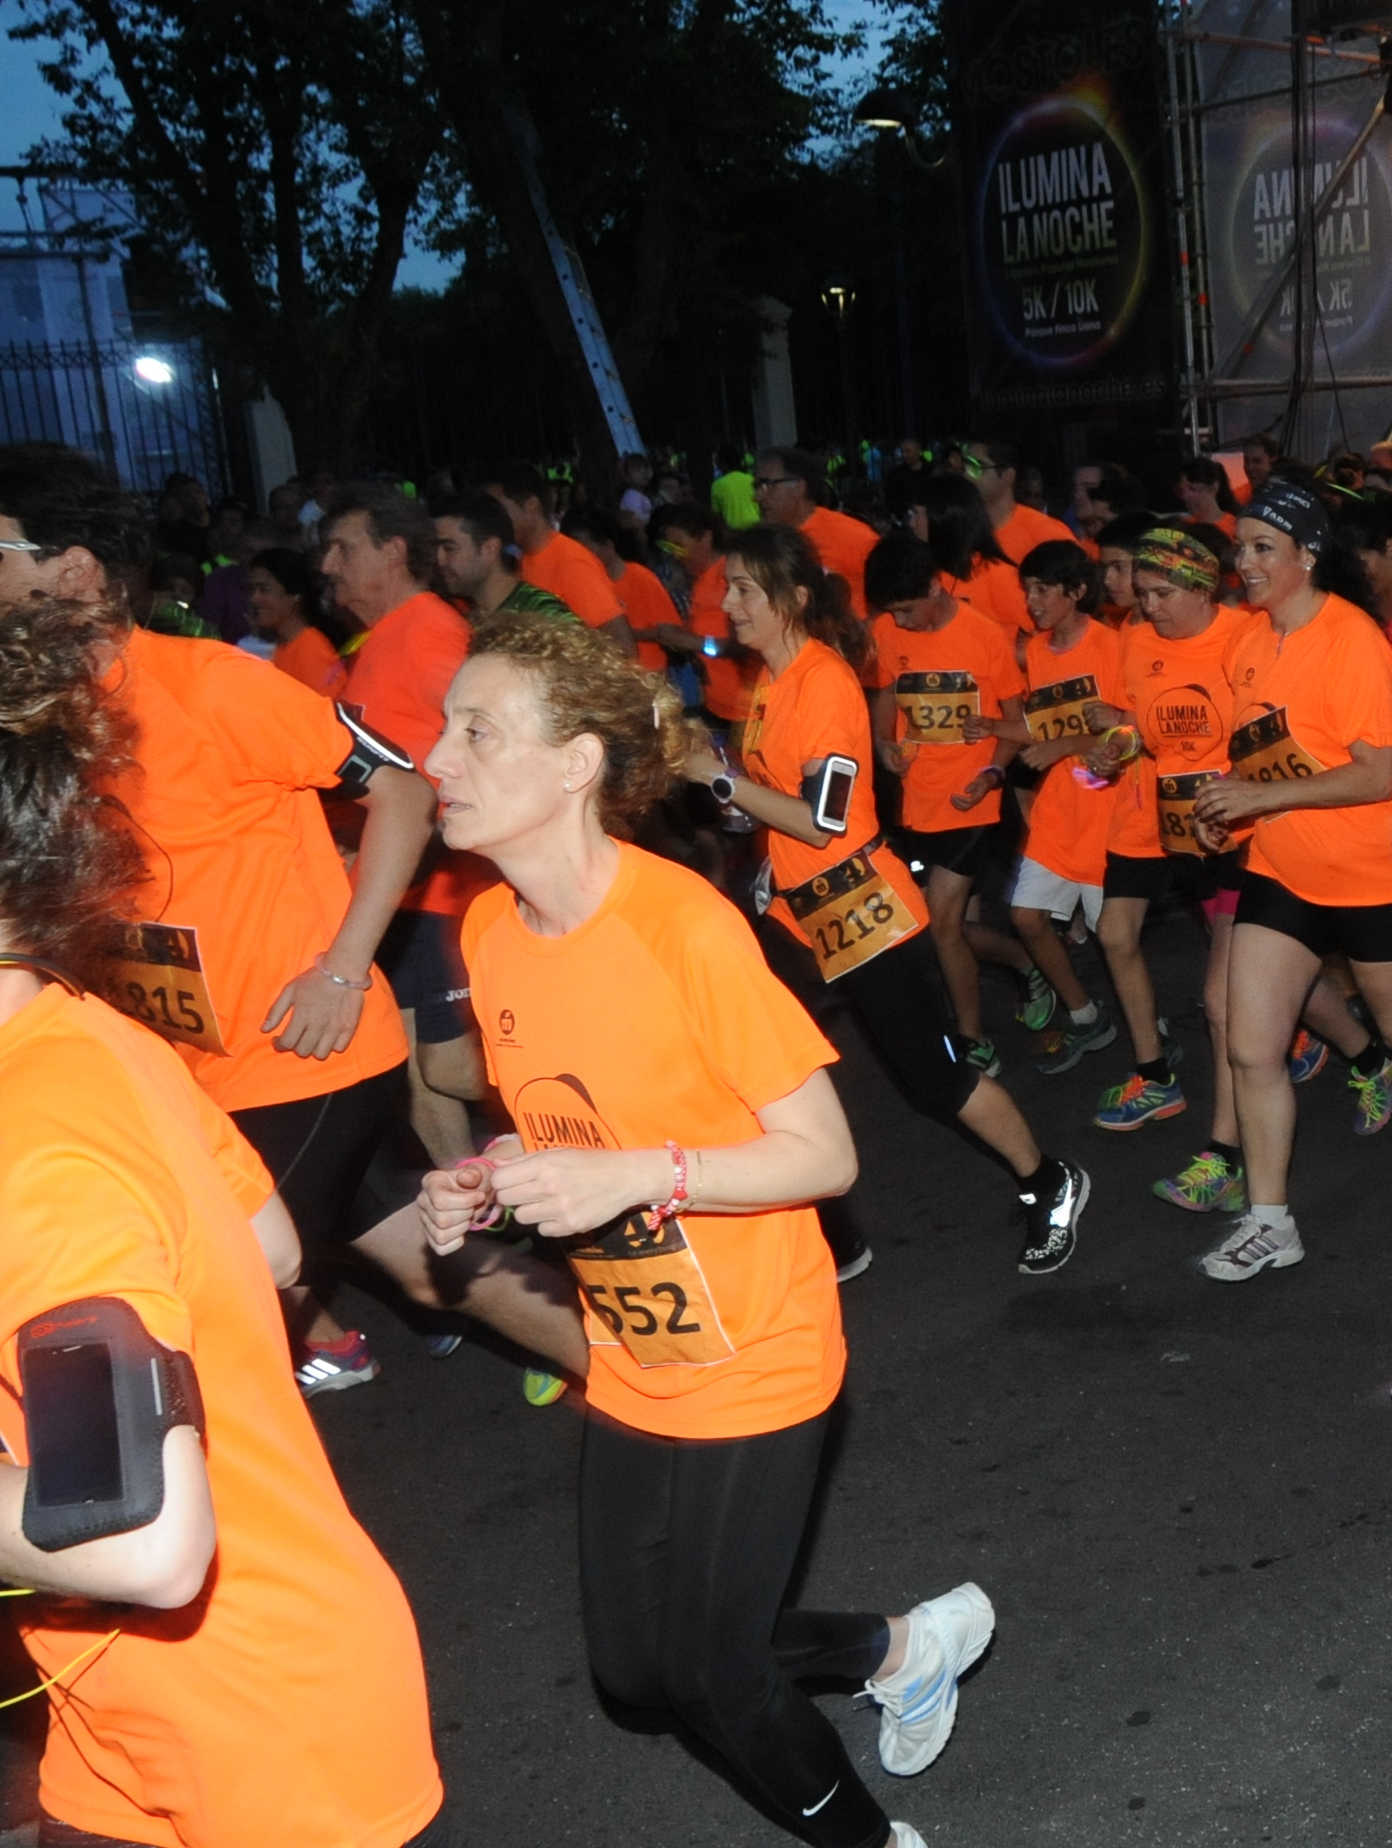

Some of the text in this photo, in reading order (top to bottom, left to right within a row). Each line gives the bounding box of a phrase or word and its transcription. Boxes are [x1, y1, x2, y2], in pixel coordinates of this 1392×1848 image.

[998, 141, 1112, 214] ILUMINA
[1022, 284, 1047, 320] 5K
[1063, 277, 1099, 315] 10K
[905, 704, 972, 729] 1329
[1037, 710, 1091, 741] 129
[1156, 705, 1208, 721] ILUMINA
[815, 892, 894, 960] 1218
[125, 980, 205, 1034] 815
[523, 1111, 606, 1149] ILUMINA
